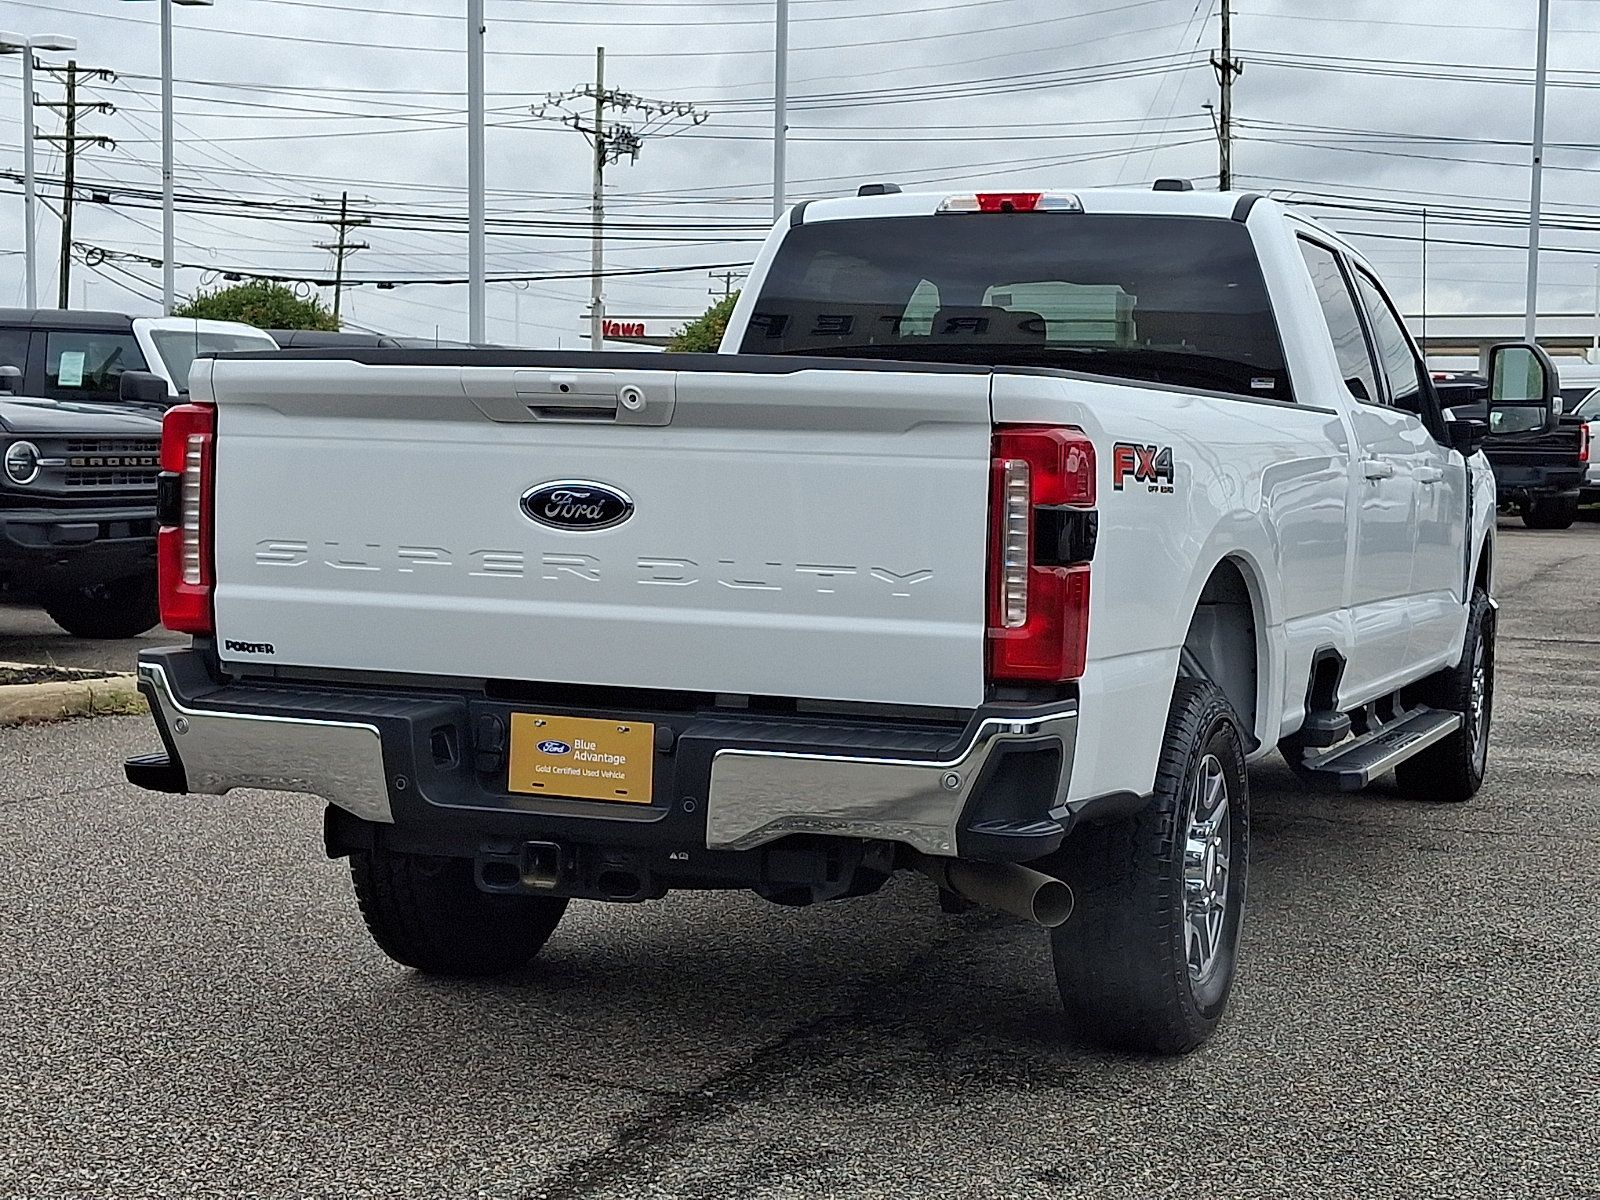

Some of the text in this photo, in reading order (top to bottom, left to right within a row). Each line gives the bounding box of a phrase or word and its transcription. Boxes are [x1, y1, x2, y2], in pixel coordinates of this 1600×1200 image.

[71, 457, 161, 466] BRONC
[1113, 442, 1174, 491] FX4
[544, 490, 605, 519] Ford
[255, 539, 934, 597] SUPER DUTY
[225, 639, 275, 655] PORTER
[542, 739, 597, 753] Ford Blue
[573, 750, 626, 766] Advantage
[535, 764, 626, 780] Gold Certified Used Vehicle
